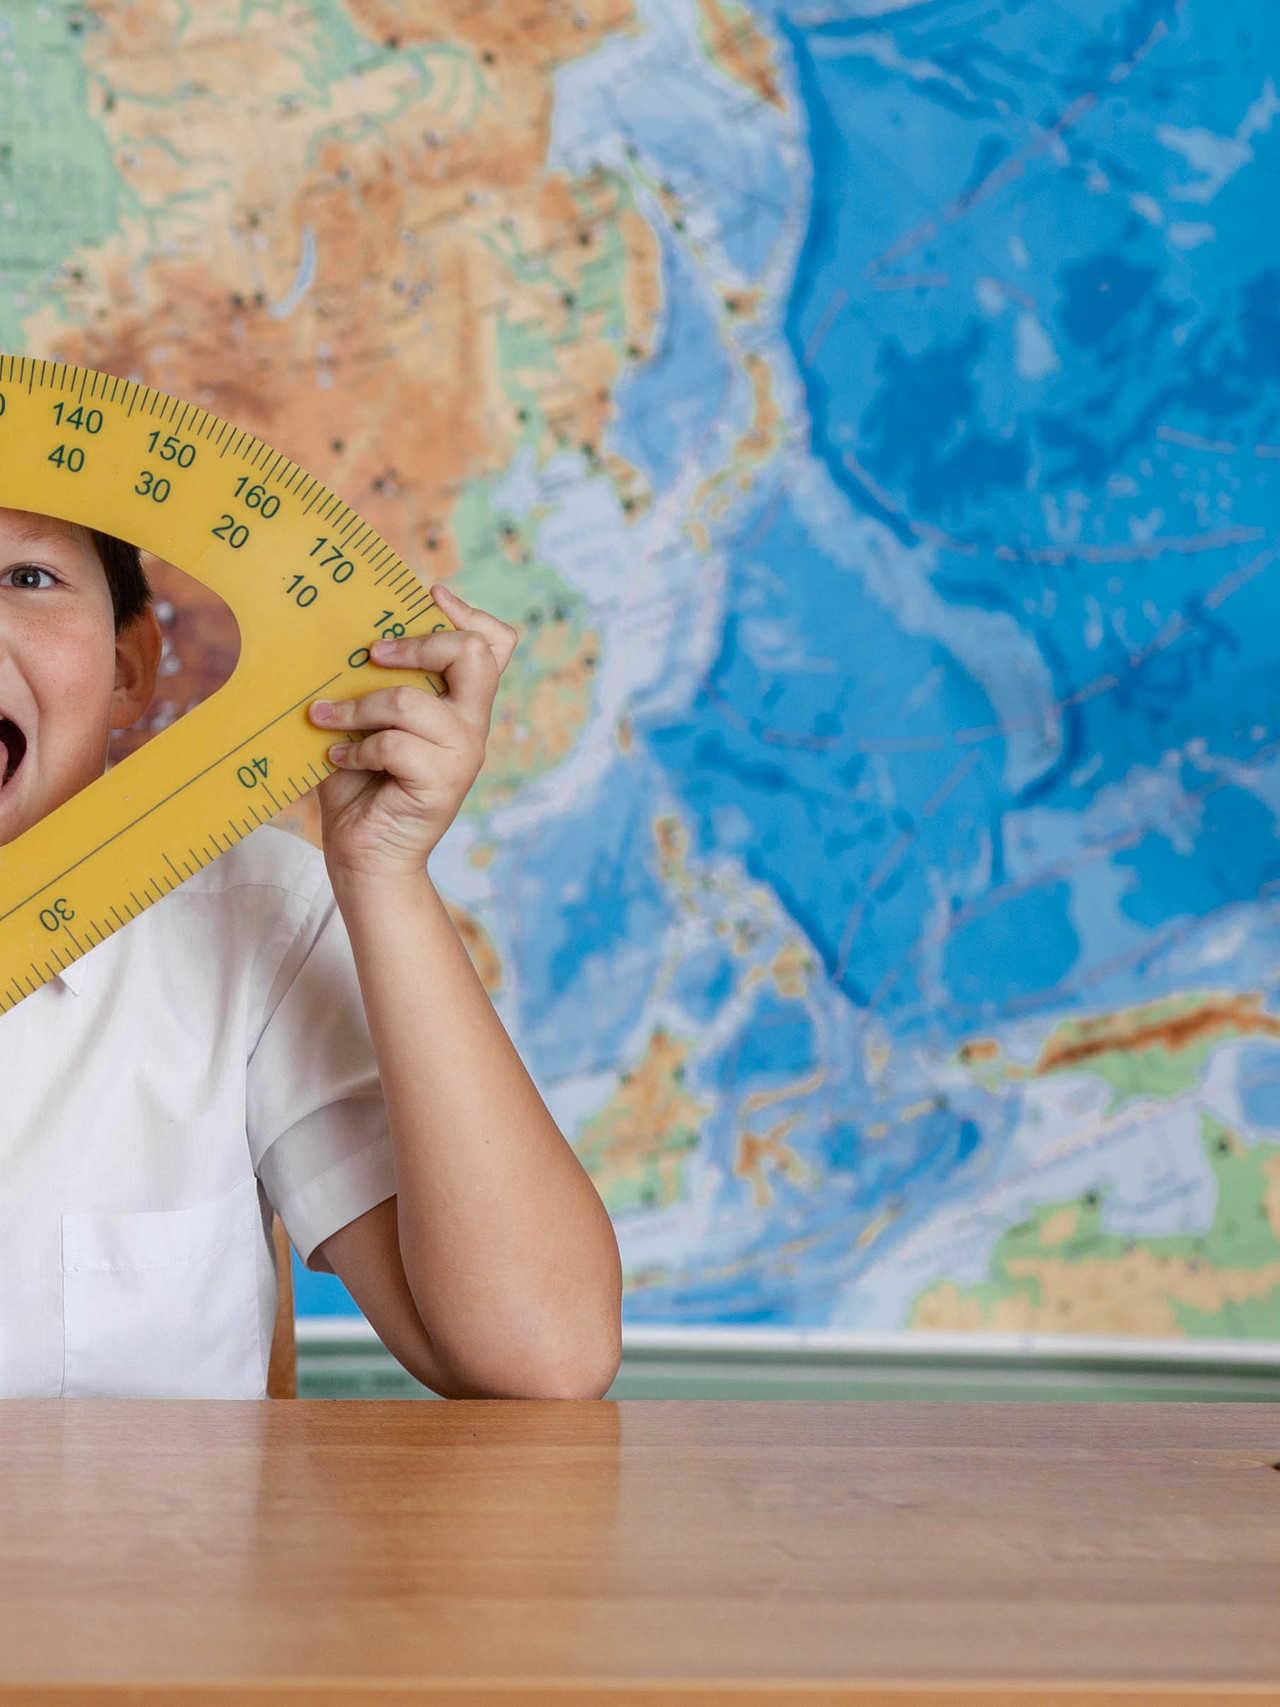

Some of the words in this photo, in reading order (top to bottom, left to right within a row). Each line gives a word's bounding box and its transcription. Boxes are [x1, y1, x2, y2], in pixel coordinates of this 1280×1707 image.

[53, 401, 104, 435] 140
[47, 444, 85, 473] 40
[148, 430, 197, 469] 150
[134, 470, 171, 504] 30
[234, 476, 281, 519] 160
[211, 514, 250, 549] 20
[307, 535, 356, 585] 170
[286, 574, 318, 608] 10
[374, 610, 406, 639] 18
[347, 647, 372, 669] 0
[235, 756, 270, 790] 40
[39, 898, 75, 932] 30
